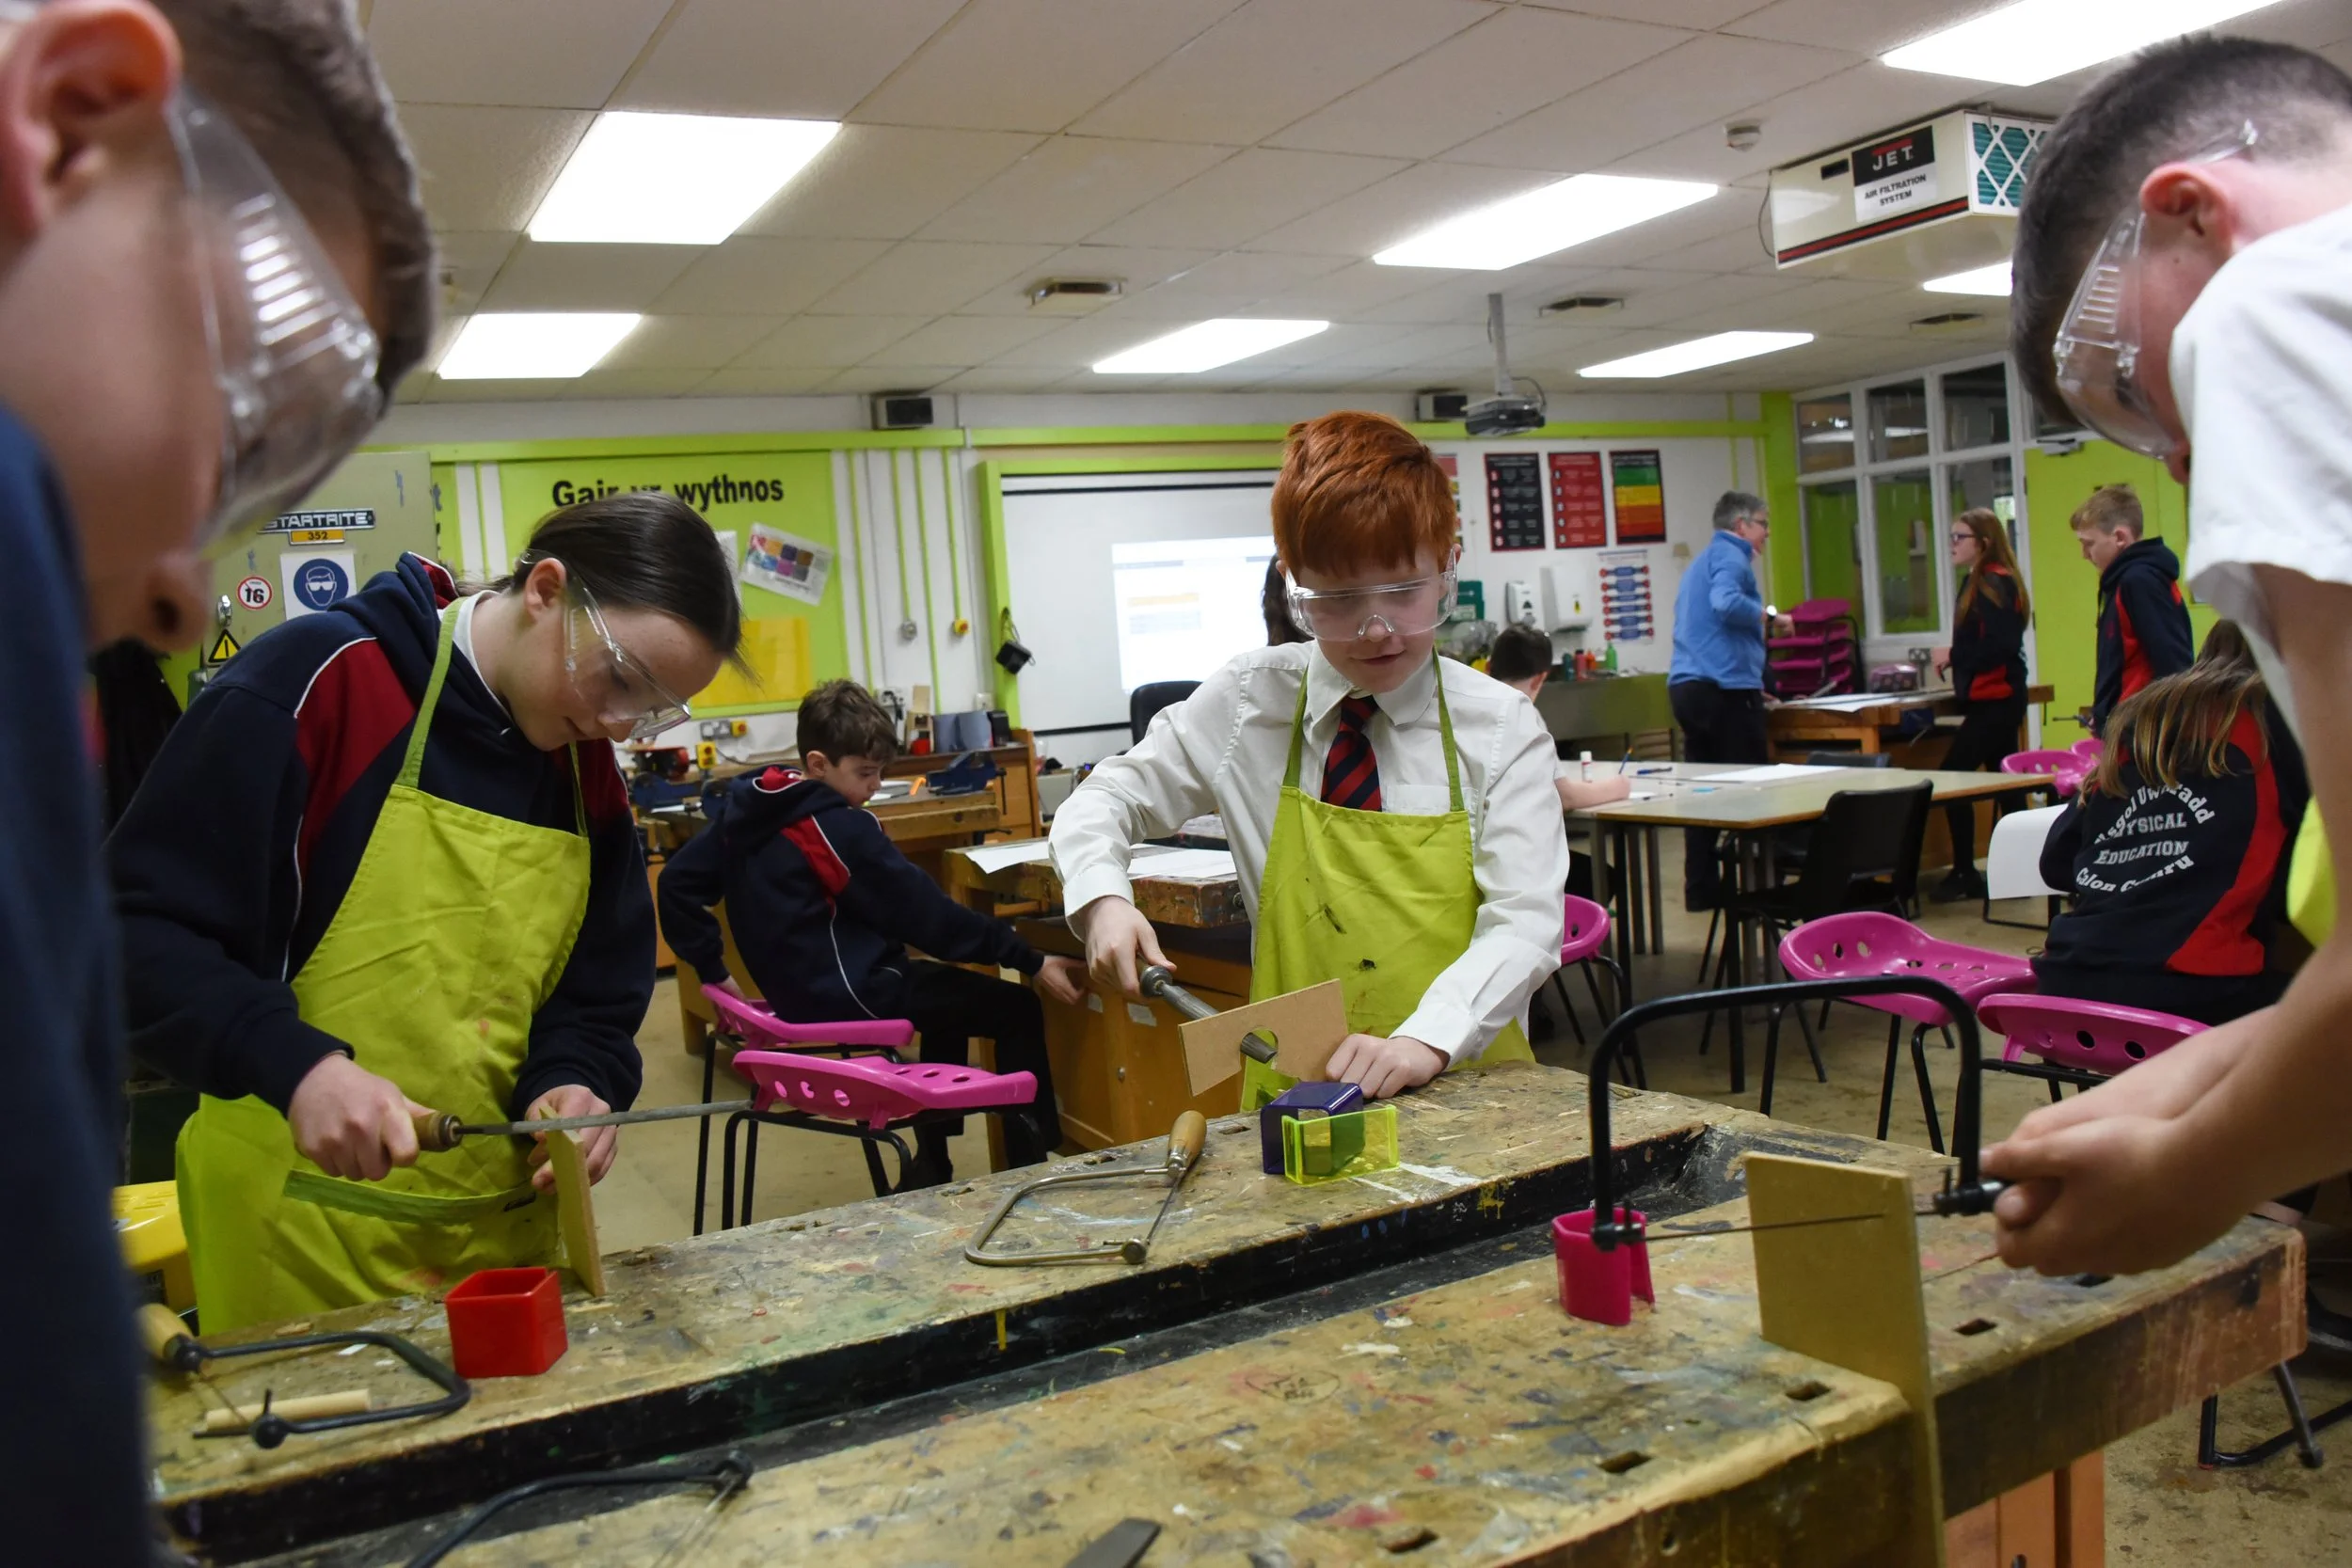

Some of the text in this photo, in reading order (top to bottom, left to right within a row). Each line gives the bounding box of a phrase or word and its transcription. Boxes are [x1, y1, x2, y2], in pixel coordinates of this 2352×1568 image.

[1872, 145, 1914, 171] JET
[1865, 174, 1927, 199] AIR FILTRATION
[1880, 190, 1913, 206] SYSTEM
[675, 473, 784, 513] wythnos
[308, 531, 328, 541] 352
[245, 588, 264, 604] 16
[2092, 840, 2189, 865] EDUCATION
